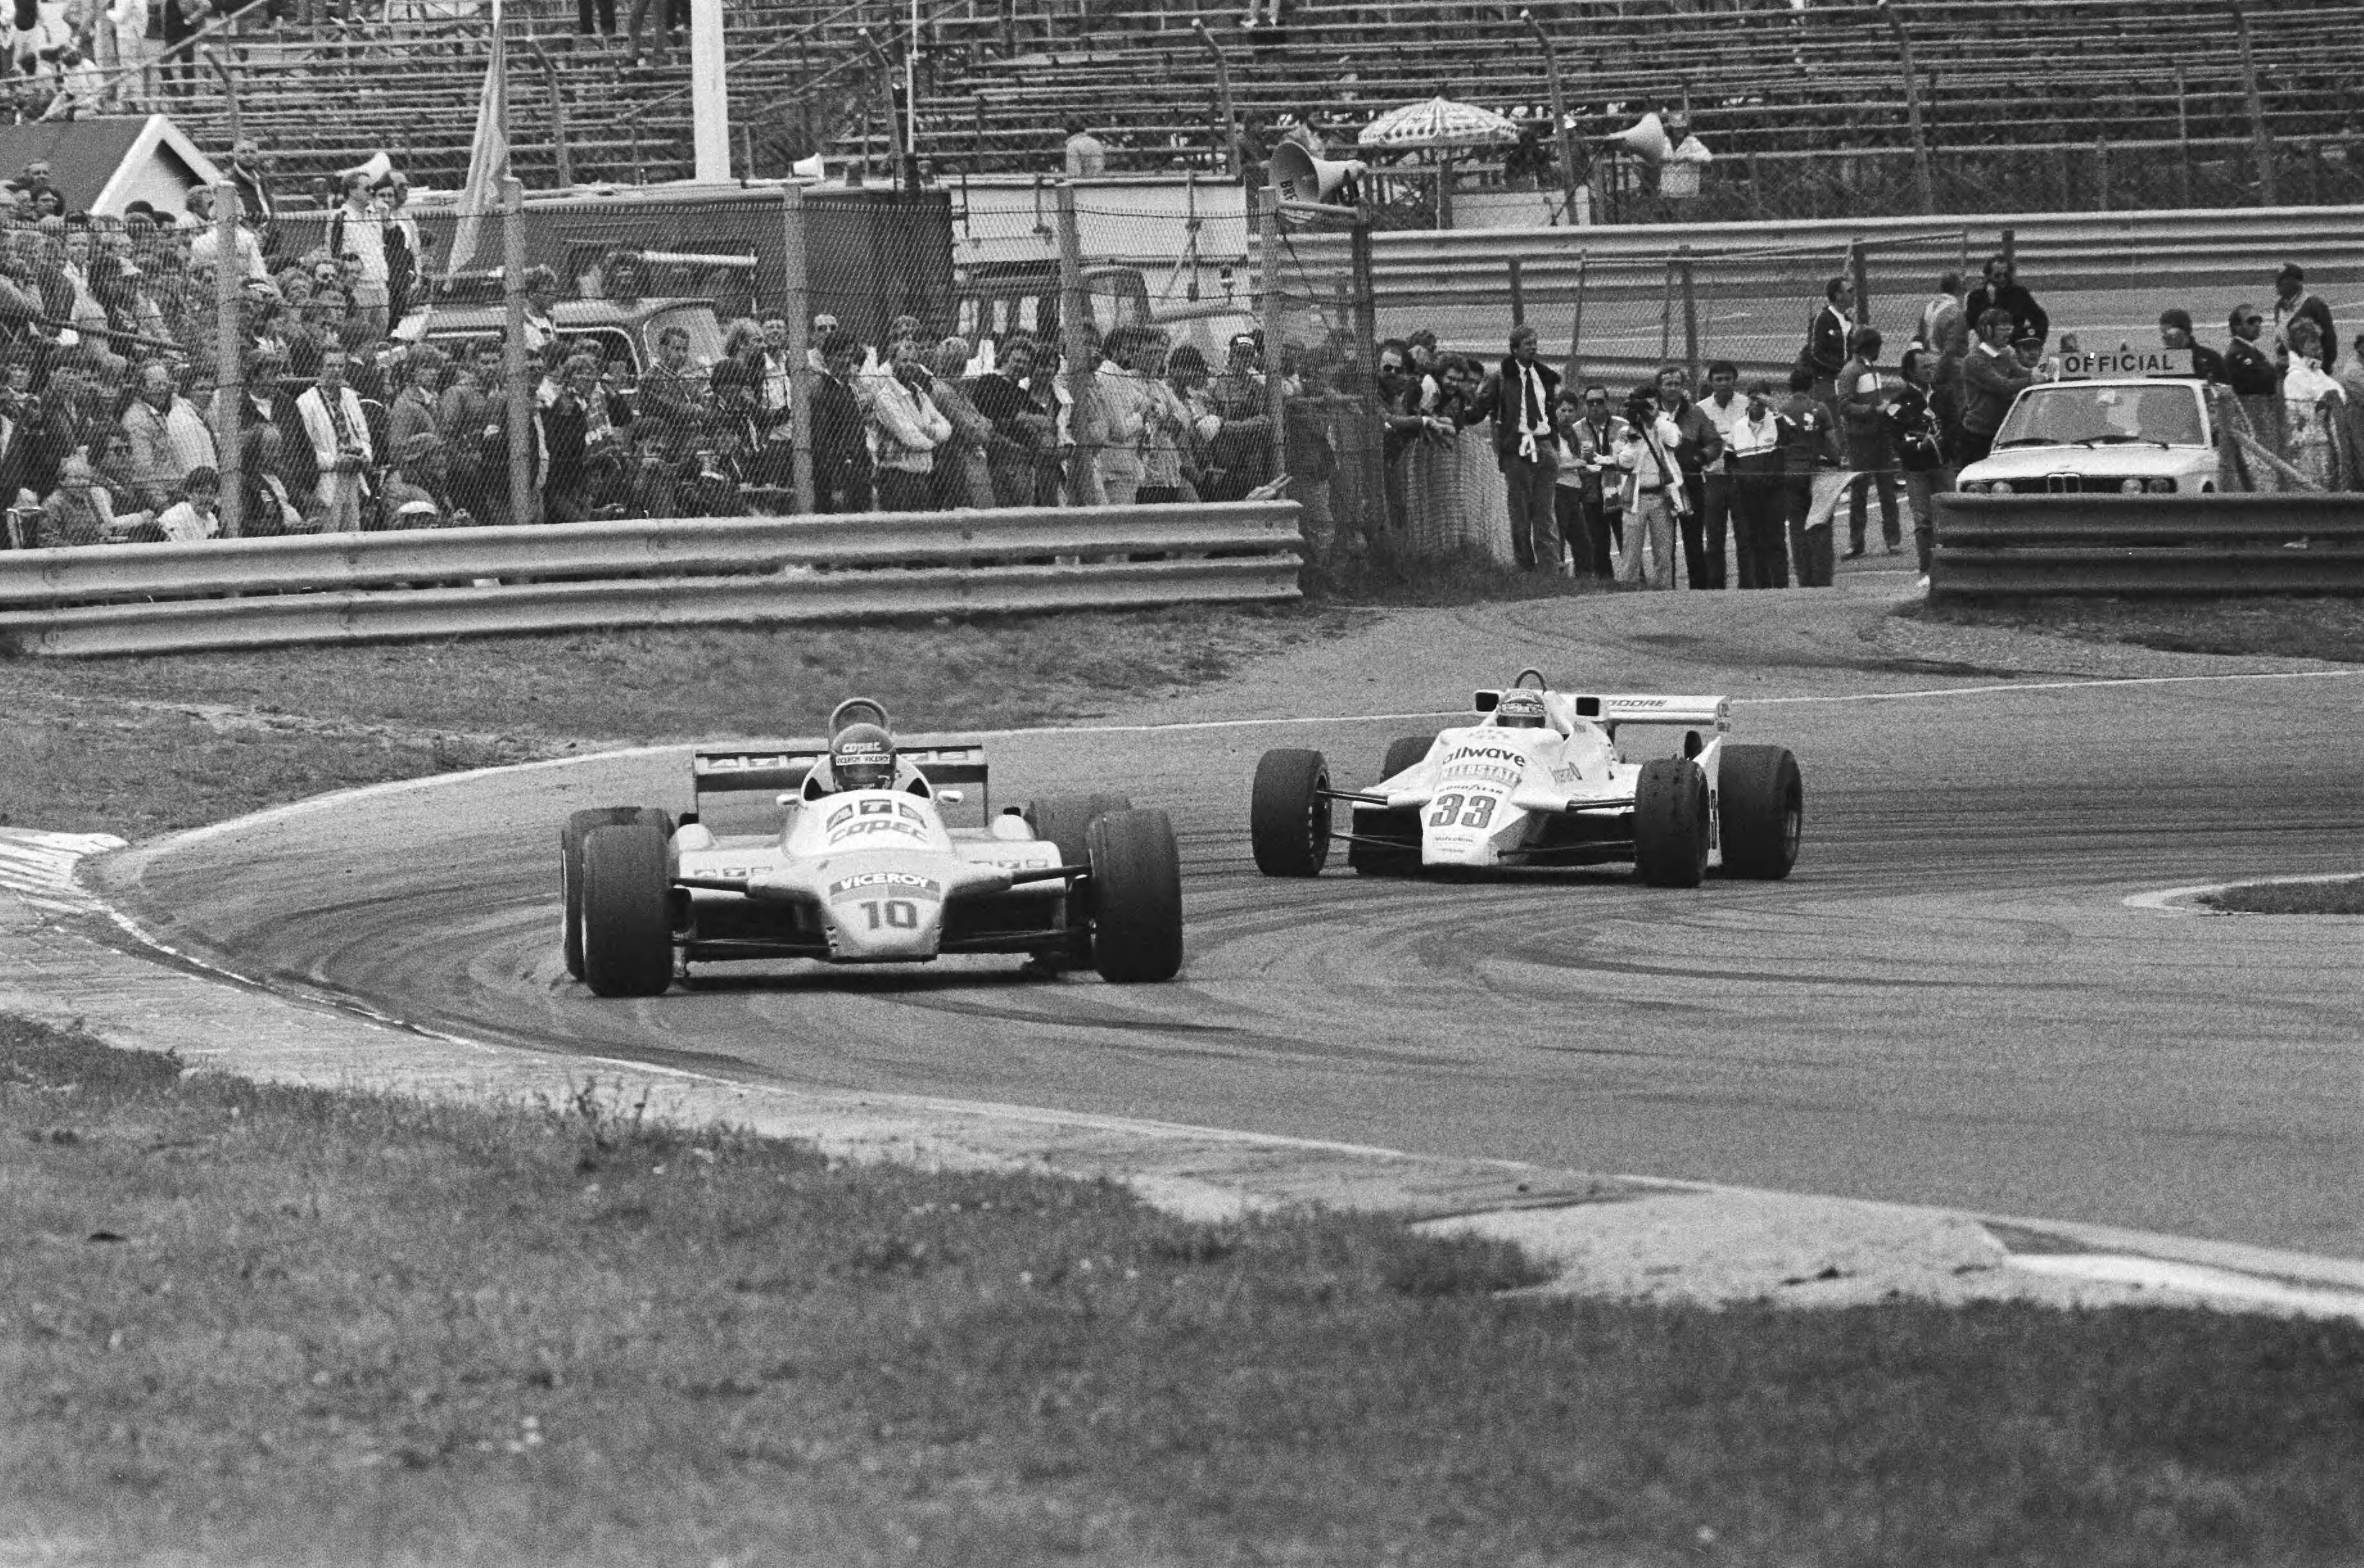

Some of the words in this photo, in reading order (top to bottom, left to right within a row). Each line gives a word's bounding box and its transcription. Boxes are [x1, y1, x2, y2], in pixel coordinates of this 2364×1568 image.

[2065, 354, 2173, 372] OFFICIAL
[1443, 747, 1526, 767] allwave
[1429, 794, 1497, 828] 33
[840, 873, 928, 890] VICEROY
[860, 900, 917, 929] 10
